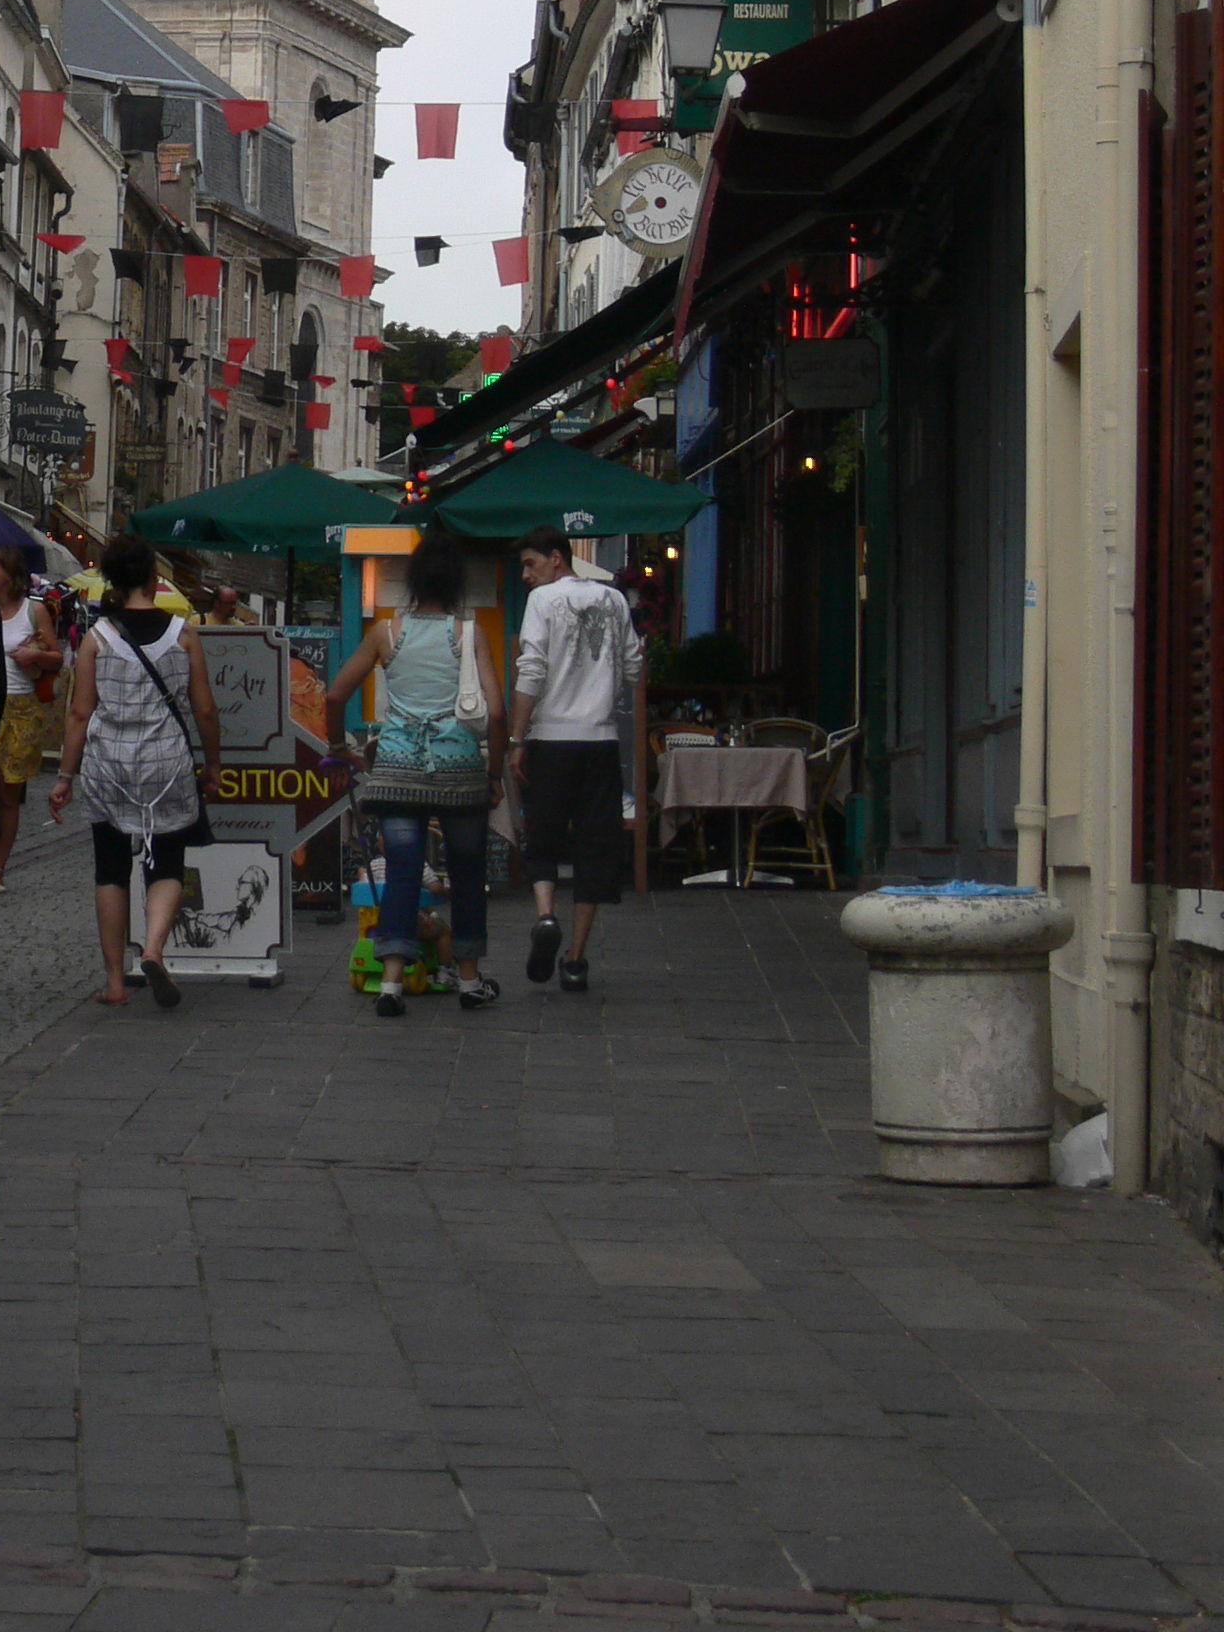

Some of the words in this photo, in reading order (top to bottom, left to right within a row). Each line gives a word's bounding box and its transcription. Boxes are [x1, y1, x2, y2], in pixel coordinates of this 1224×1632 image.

[733, 3, 790, 19] RESTAURANT
[13, 401, 82, 422] Boulangerie
[16, 427, 82, 446] Notre-Dame
[562, 509, 595, 532] Perrier
[215, 664, 266, 701] d'Art
[196, 768, 330, 799] SITION
